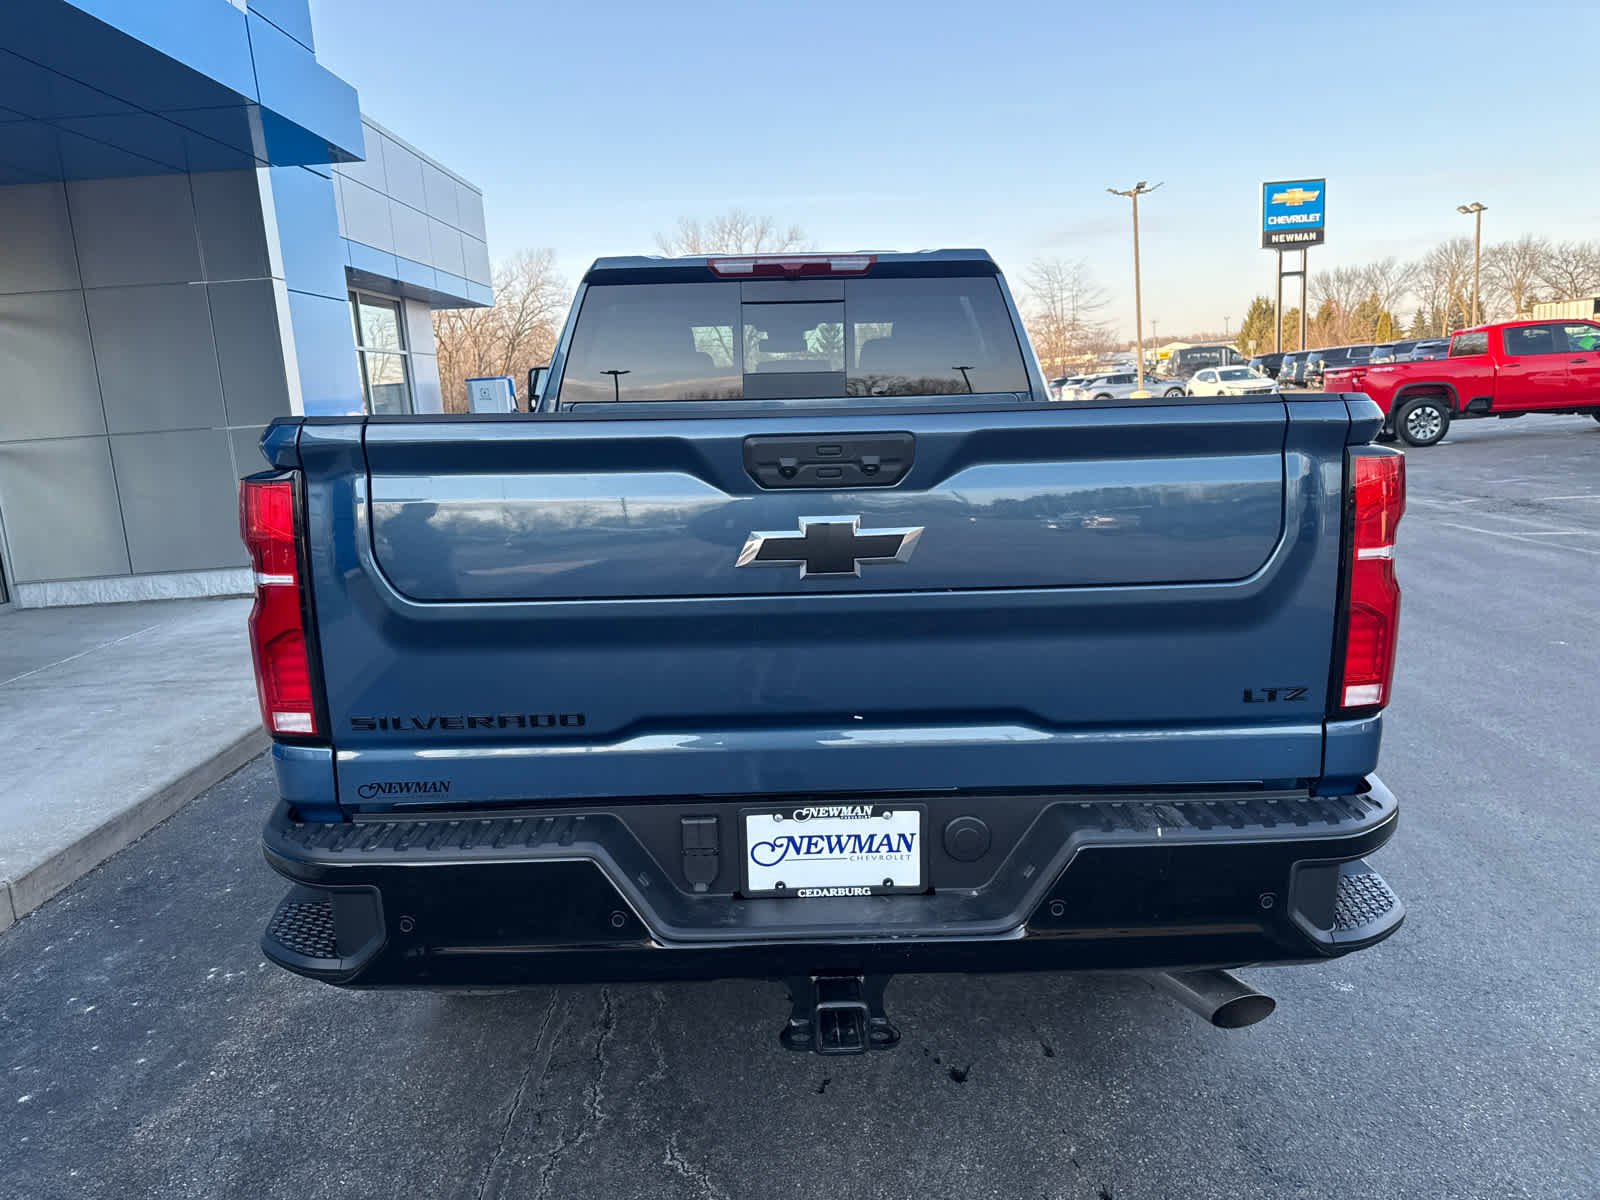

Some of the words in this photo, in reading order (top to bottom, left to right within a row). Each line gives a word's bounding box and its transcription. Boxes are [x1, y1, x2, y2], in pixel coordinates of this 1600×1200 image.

[1268, 213, 1321, 224] CHEVROLET
[1271, 232, 1317, 243] NEWMAN
[1242, 686, 1309, 703] LTZ
[351, 712, 586, 731] SILVERADO
[358, 781, 450, 799] NEWMAN
[793, 805, 873, 823] NEWMAN
[751, 833, 916, 867] NEWMAN
[849, 854, 911, 862] CHEVROLET
[797, 887, 871, 898] CEDARBURG
